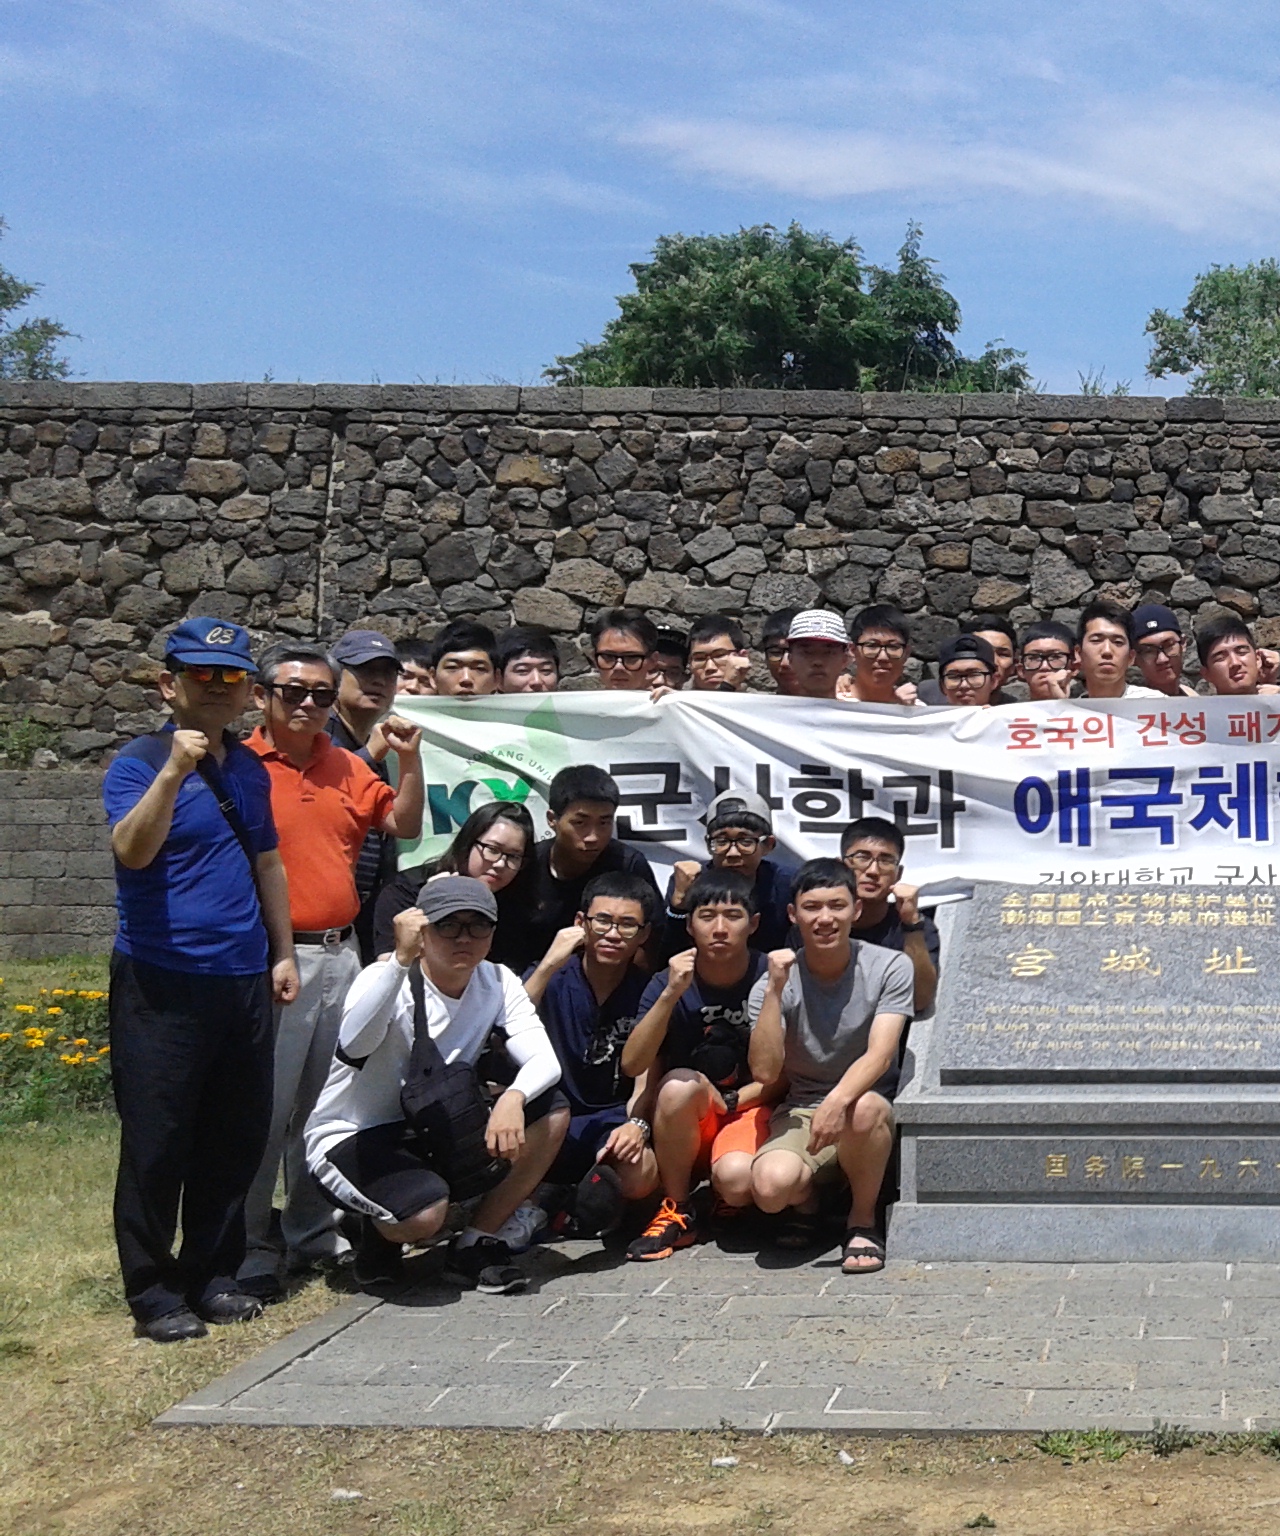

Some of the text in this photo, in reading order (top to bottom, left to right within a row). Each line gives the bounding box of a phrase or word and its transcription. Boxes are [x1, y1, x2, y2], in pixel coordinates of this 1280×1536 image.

[1006, 717, 1115, 750] 호국의
[1136, 712, 1207, 746] 간성
[608, 761, 966, 849] 군사학과
[1006, 942, 1258, 978] 宫城址
